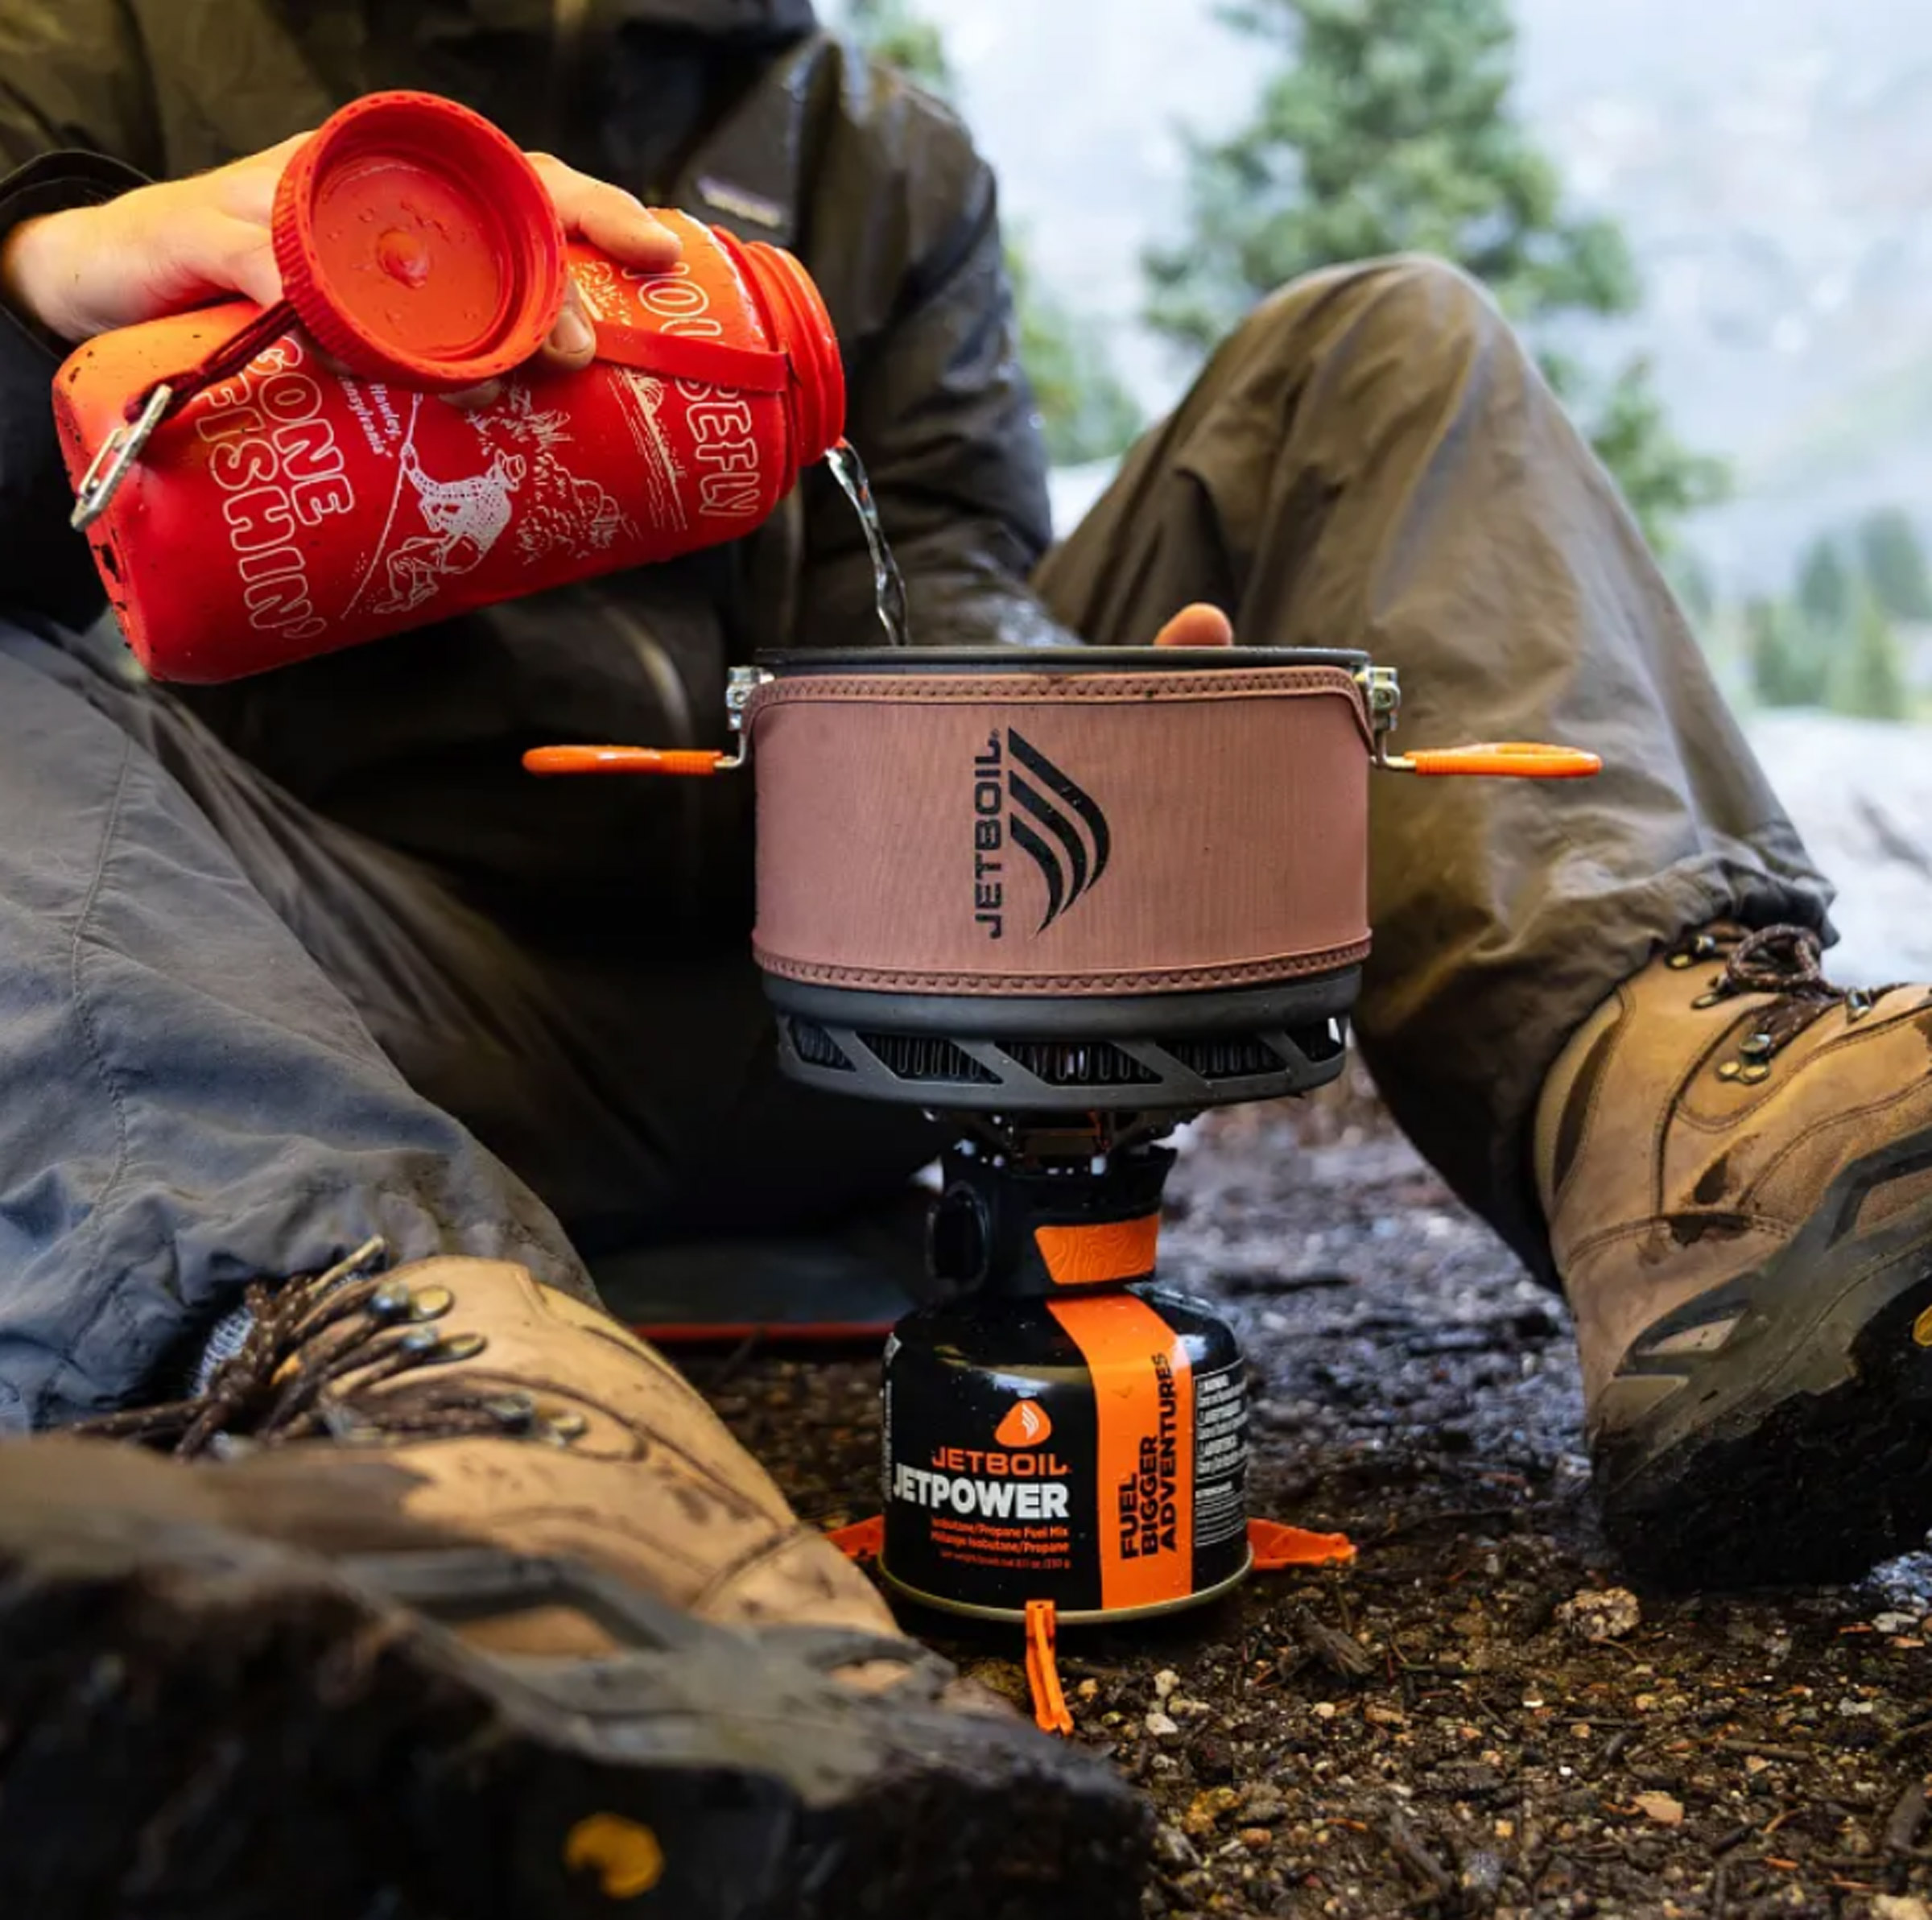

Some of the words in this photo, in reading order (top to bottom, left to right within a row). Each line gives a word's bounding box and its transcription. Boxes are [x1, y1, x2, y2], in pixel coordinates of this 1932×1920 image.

[246, 335, 355, 526] GONE
[975, 738, 1003, 939] JETBOIL
[894, 1463, 1070, 1519] JETPOWER
[932, 1447, 1070, 1476] JETBOIL
[1140, 1435, 1159, 1556] BIGGER
[1152, 1352, 1177, 1552] ADVENTURES
[1119, 1472, 1139, 1559] FUEL
